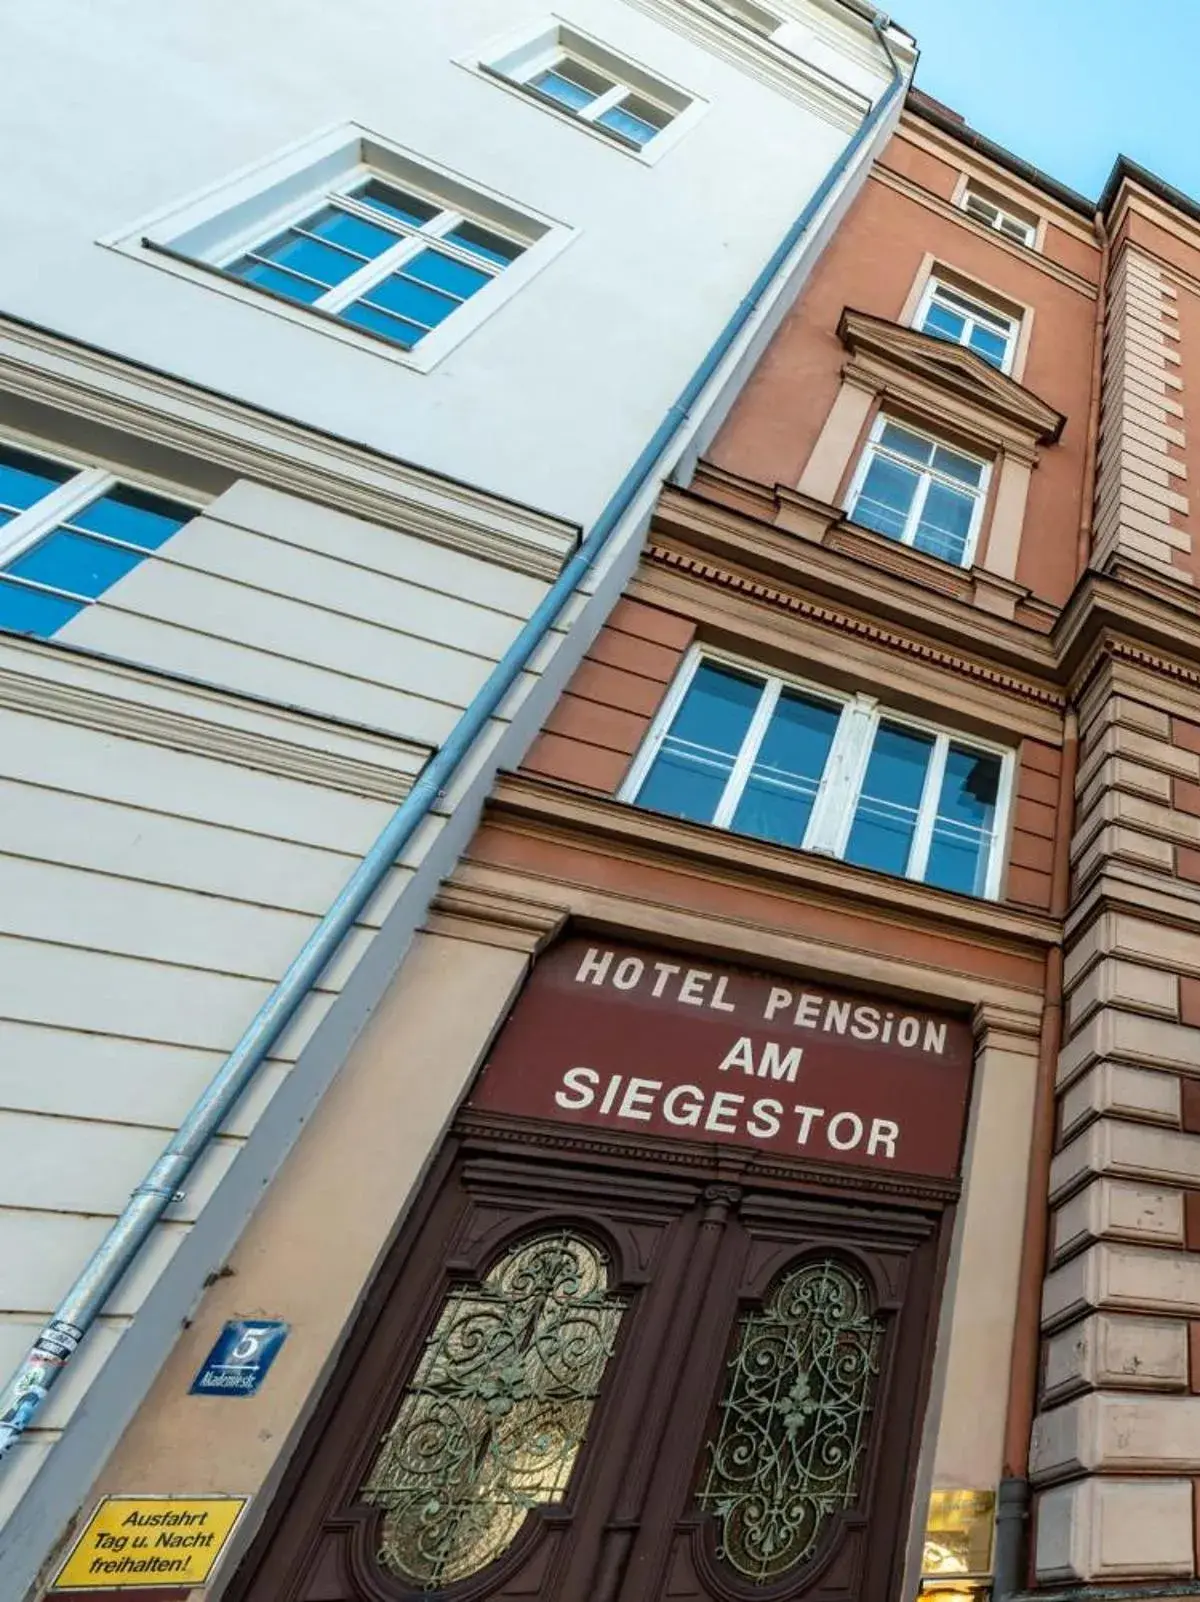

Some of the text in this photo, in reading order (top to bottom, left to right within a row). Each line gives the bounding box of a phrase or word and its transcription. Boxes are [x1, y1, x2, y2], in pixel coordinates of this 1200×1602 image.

[575, 948, 735, 1012] HOTEL
[718, 1036, 804, 1083] AM
[555, 1066, 899, 1159] SIEGESTOR
[232, 1327, 270, 1359] 5
[121, 1511, 208, 1528] Ausfahrt
[94, 1532, 215, 1552] Tag u. Nacht
[89, 1555, 192, 1575] freihalten!
